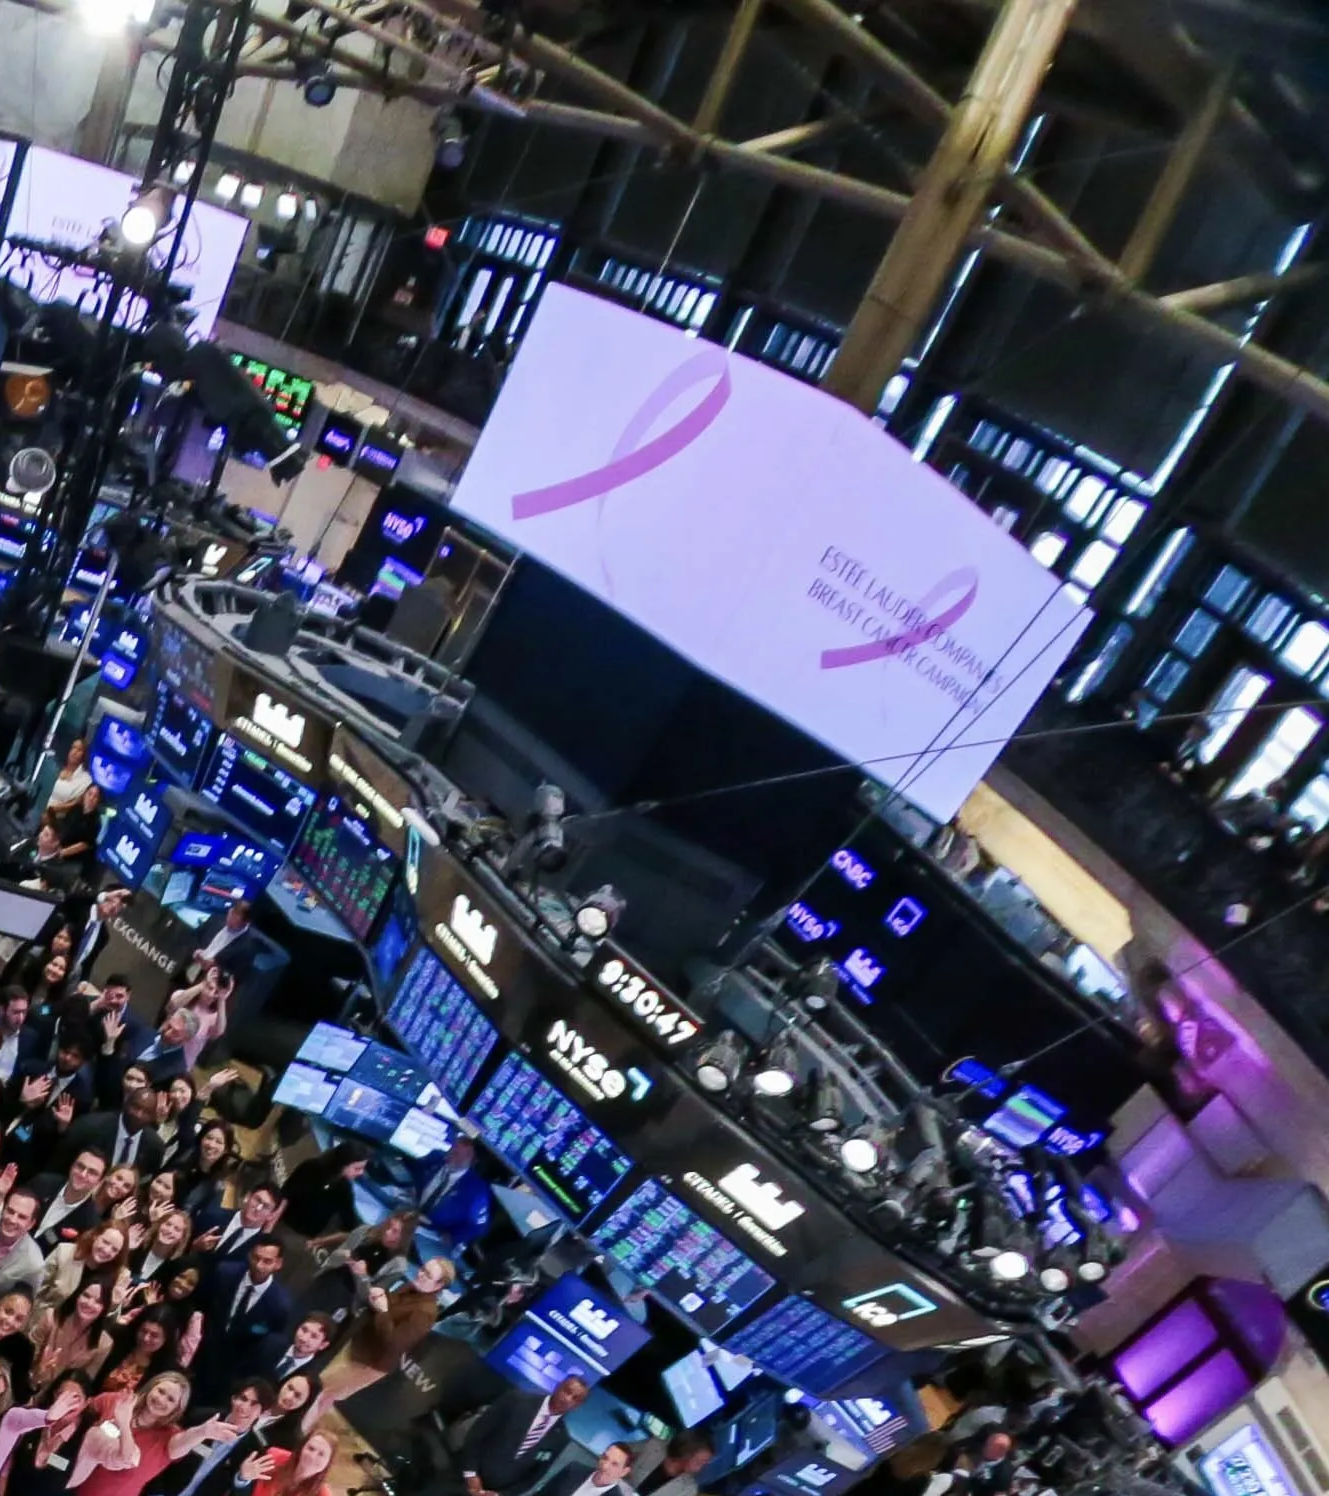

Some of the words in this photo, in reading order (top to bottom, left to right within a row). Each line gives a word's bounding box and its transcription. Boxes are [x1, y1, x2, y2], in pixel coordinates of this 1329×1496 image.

[807, 577, 864, 626] BREAST
[112, 916, 179, 975] EXCHANGE
[597, 958, 699, 1046] 9:30:47
